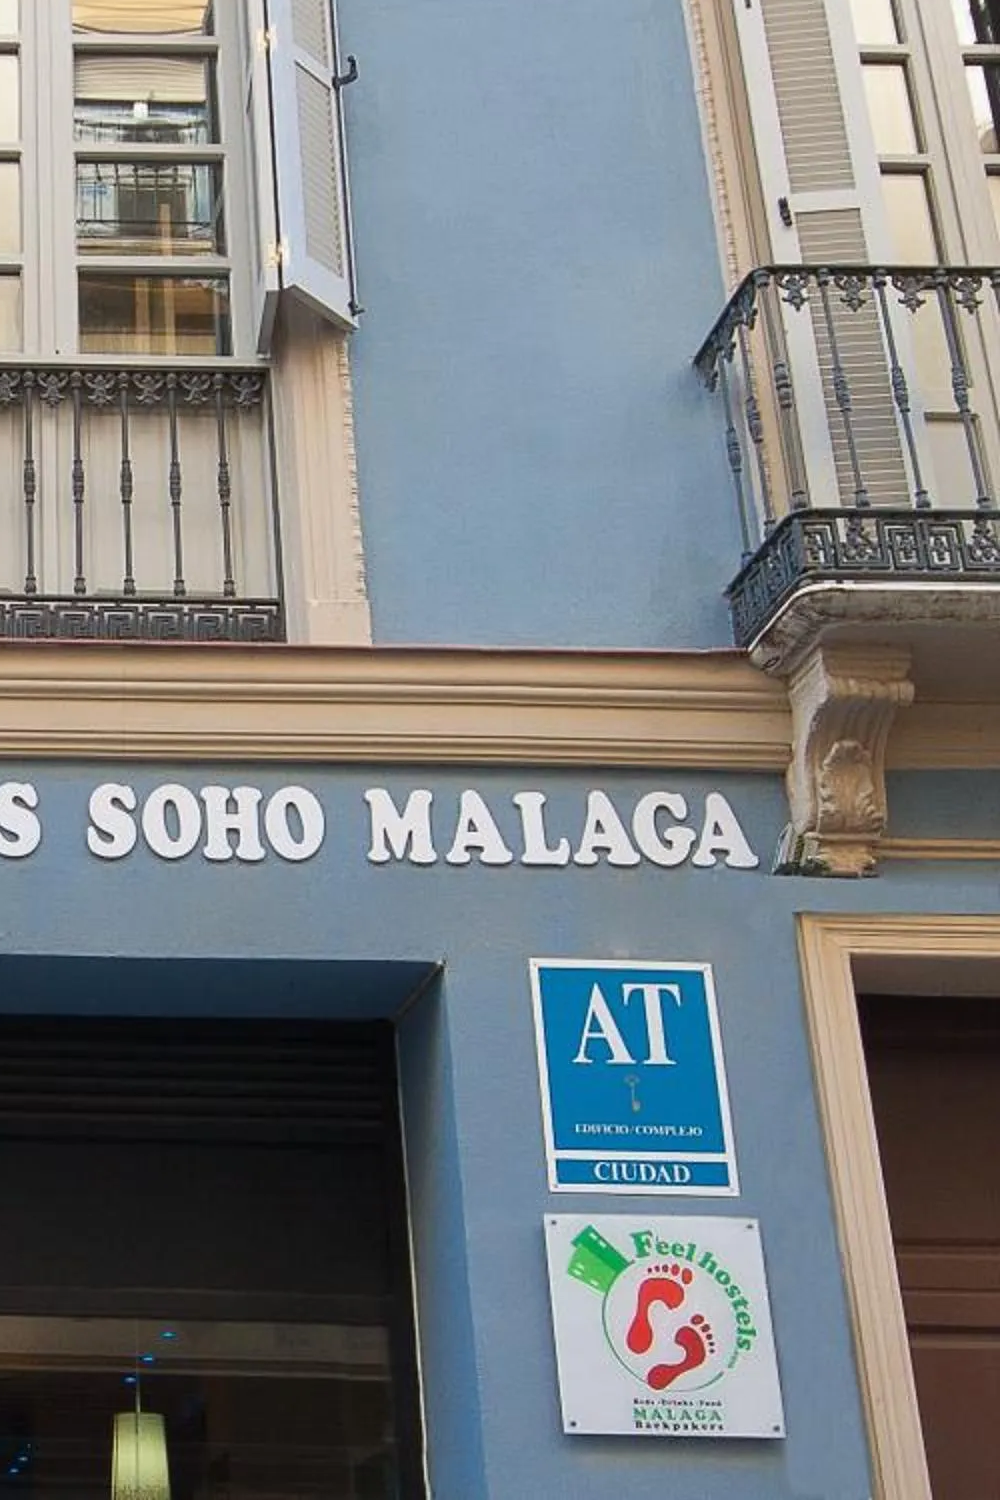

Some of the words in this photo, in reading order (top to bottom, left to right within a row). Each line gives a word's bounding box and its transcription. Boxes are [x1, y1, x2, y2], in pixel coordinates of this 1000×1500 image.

[87, 783, 326, 862] SOHO
[365, 789, 759, 867] MALAGA
[572, 982, 682, 1065] AT
[594, 1161, 691, 1183] CIUDAD
[630, 1229, 697, 1262] Feel
[698, 1252, 757, 1351] hostels
[633, 1407, 722, 1421] MALAGA
